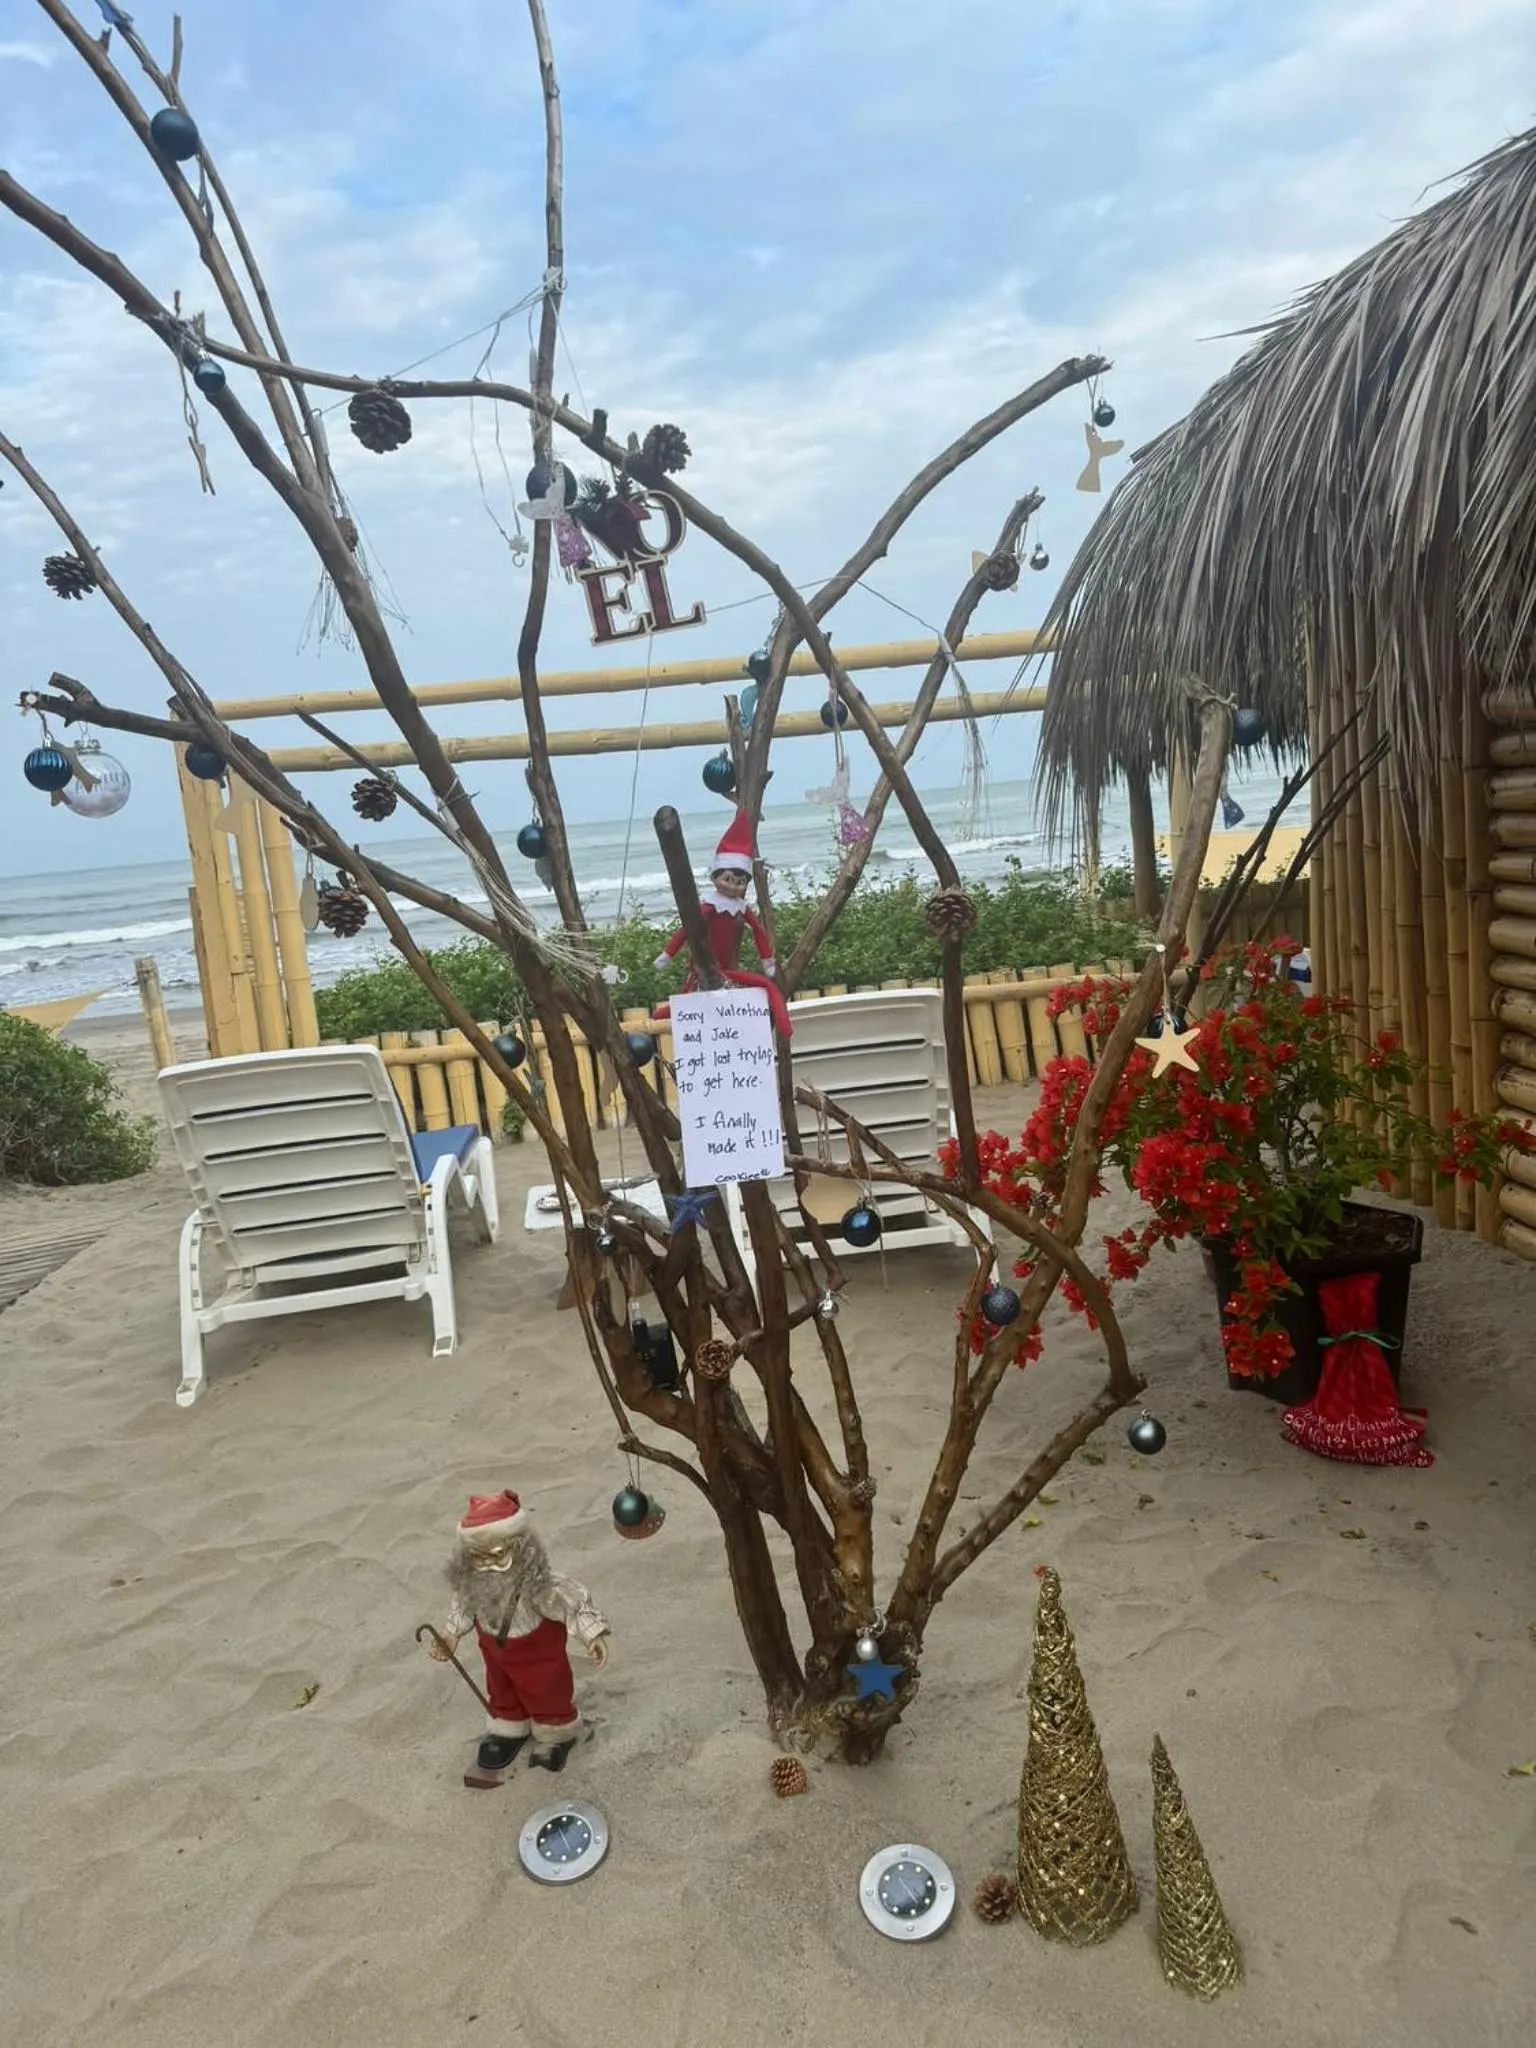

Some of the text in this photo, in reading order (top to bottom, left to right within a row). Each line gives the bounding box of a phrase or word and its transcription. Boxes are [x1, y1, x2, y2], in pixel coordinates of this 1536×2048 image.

[677, 1011, 704, 1024] Sorry
[683, 1029, 702, 1045] and
[675, 1046, 773, 1076] I got lost trying
[679, 1081, 694, 1093] to
[704, 1072, 724, 1097] get
[695, 1110, 757, 1132] I finally
[745, 1131, 755, 1148] it
